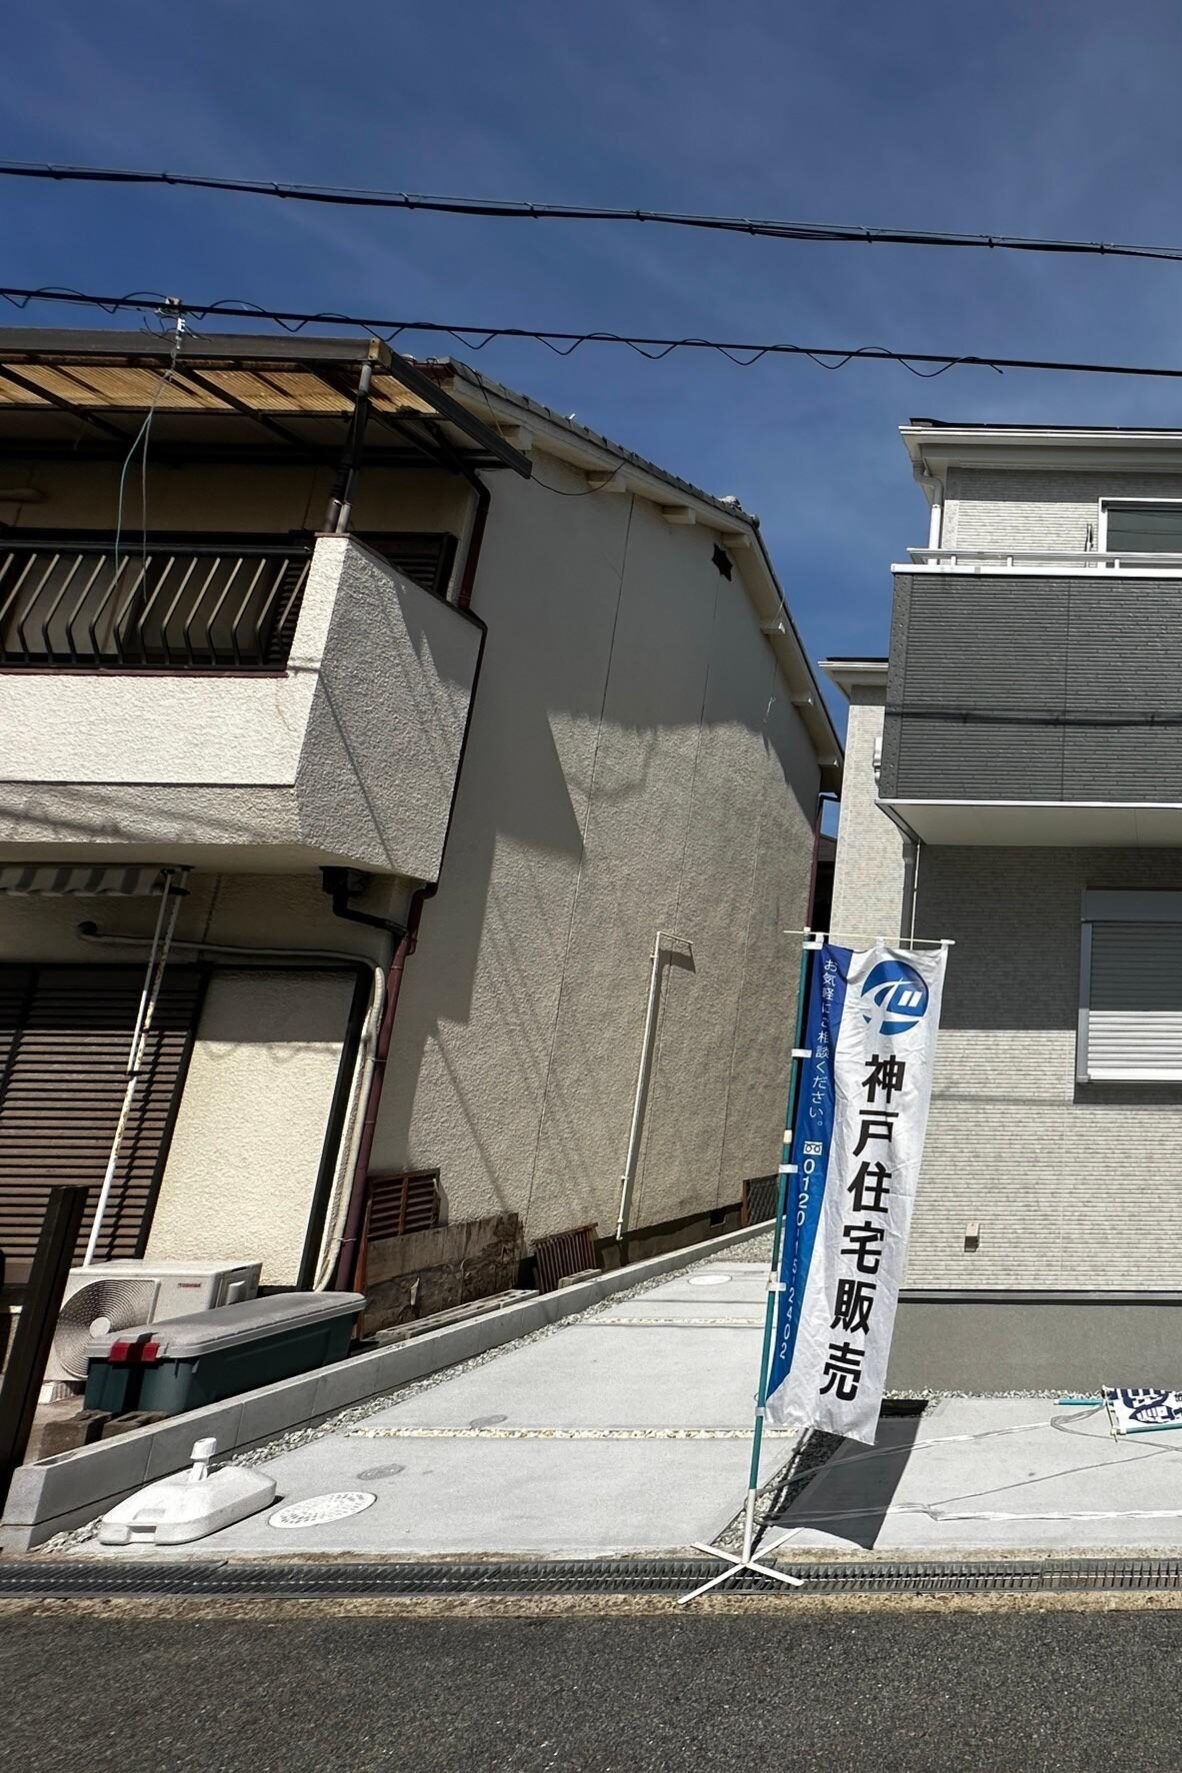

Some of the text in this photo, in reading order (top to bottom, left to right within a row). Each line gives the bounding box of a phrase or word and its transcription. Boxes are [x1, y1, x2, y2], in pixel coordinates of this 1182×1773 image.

[819, 1054, 905, 1402] 神戸住宅販売
